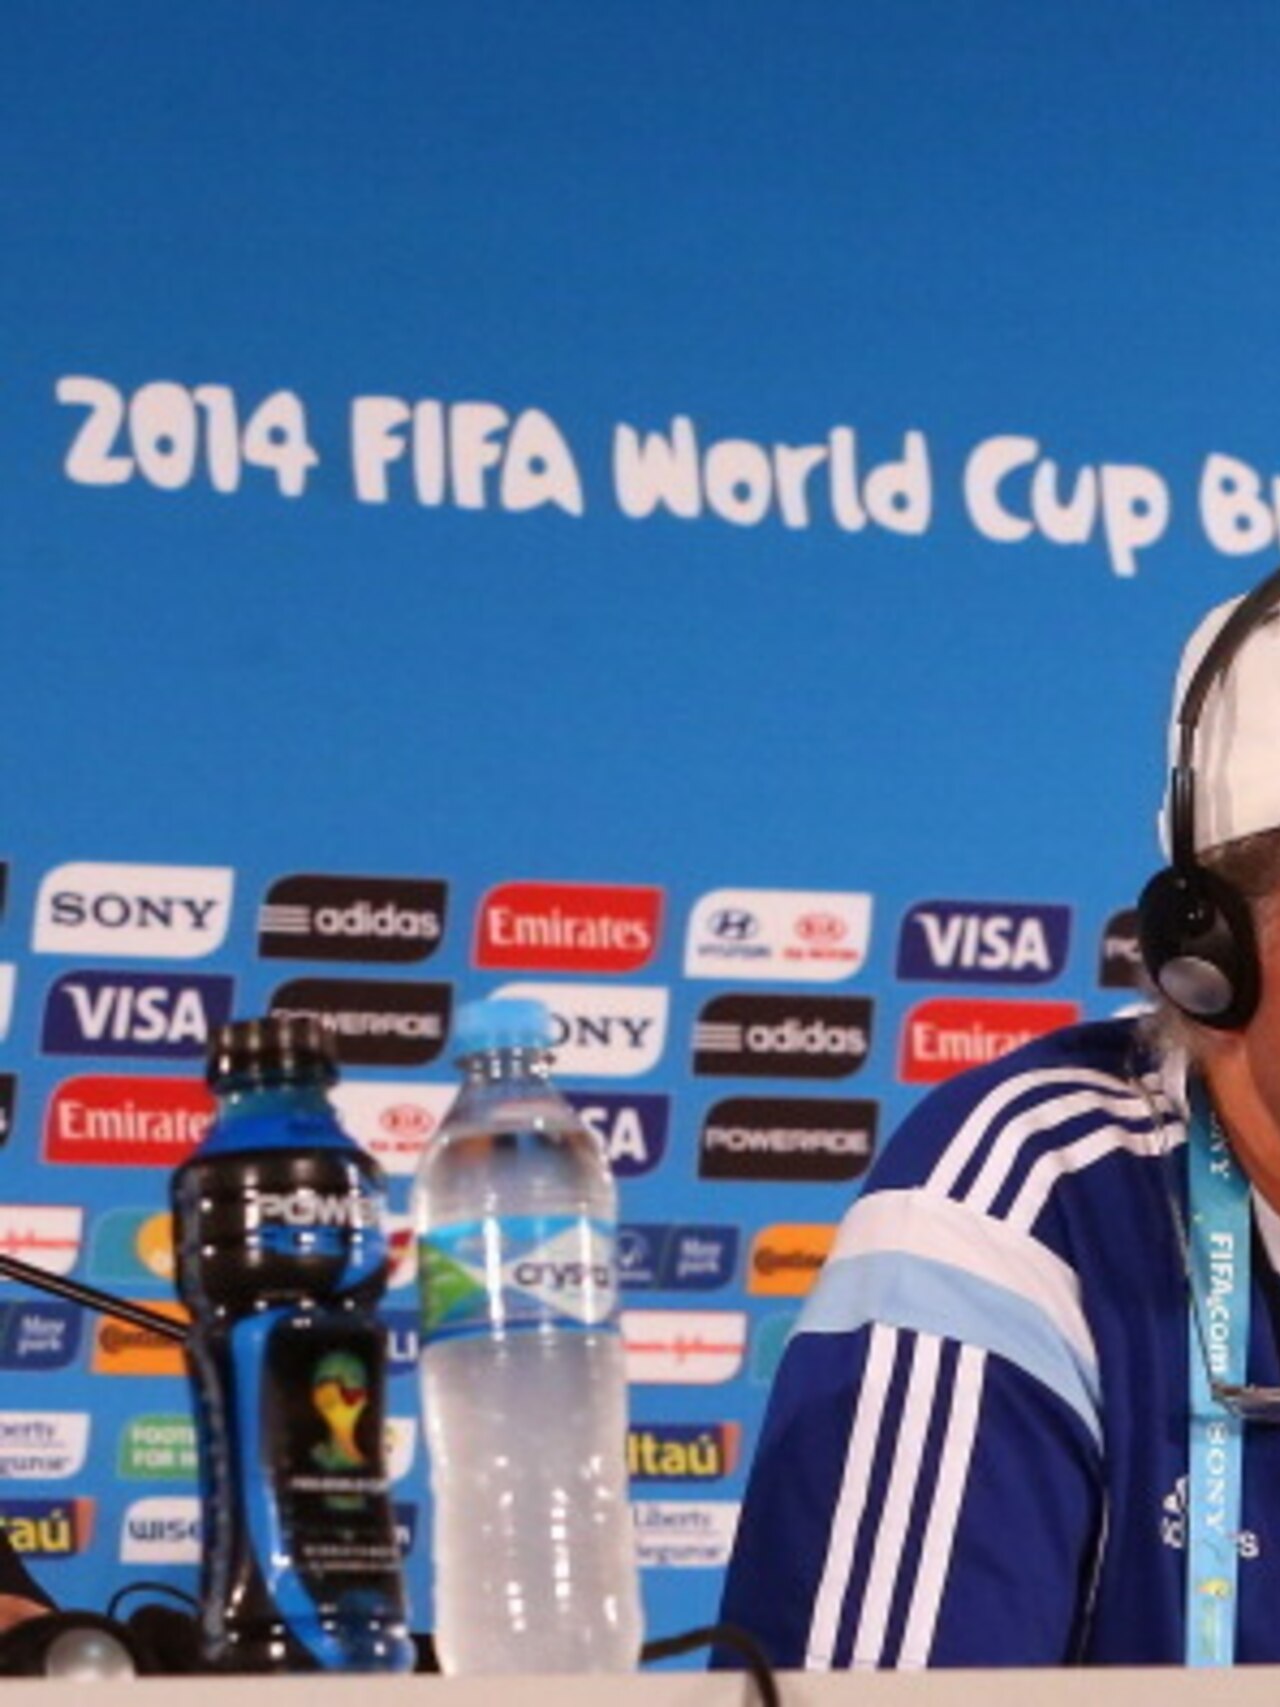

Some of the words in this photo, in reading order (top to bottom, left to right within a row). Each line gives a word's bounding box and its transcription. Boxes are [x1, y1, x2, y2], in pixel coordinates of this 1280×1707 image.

[56, 376, 319, 498] 2014
[352, 396, 584, 518] FIFA
[613, 415, 932, 533] World
[964, 434, 1170, 578] Cup
[51, 891, 217, 930] SONY
[315, 903, 441, 940] adidas
[488, 906, 652, 951] Emirates
[916, 911, 1052, 972] VISA
[61, 984, 209, 1045] VISA
[748, 1020, 867, 1056] adidas
[58, 1100, 215, 1144] Emirate
[627, 1433, 718, 1476] Itaú
[1206, 1420, 1228, 1538] SONY
